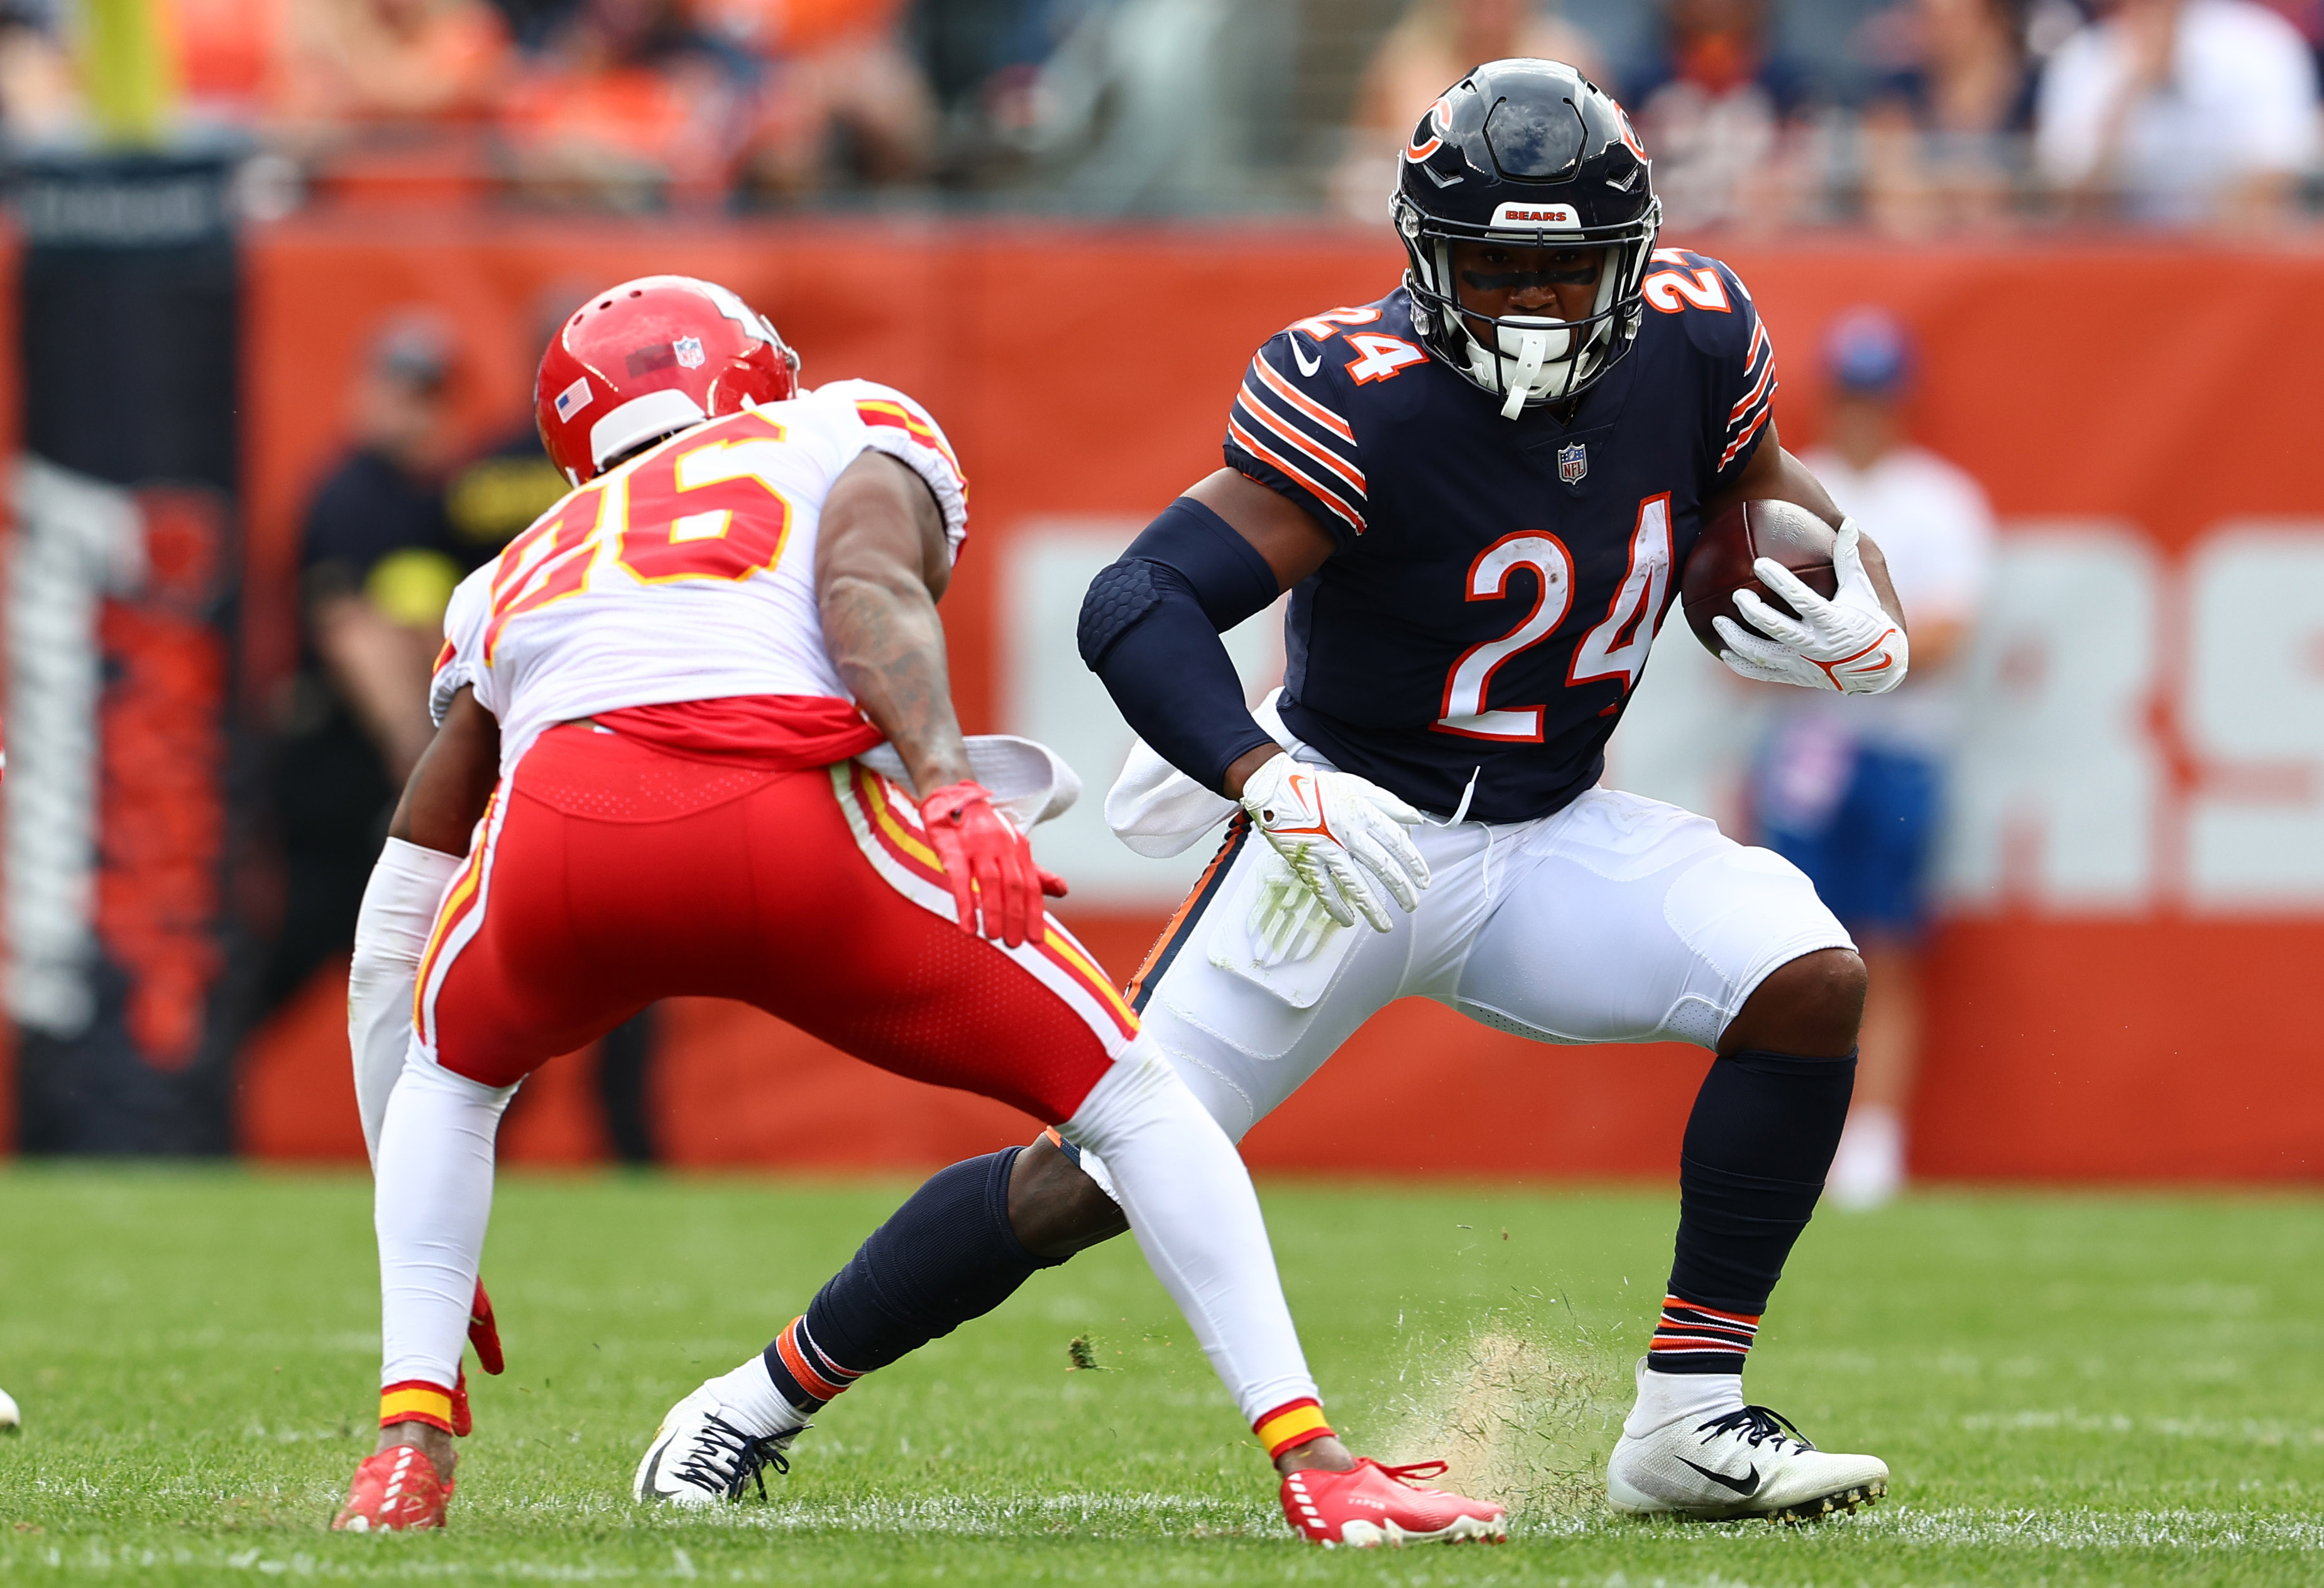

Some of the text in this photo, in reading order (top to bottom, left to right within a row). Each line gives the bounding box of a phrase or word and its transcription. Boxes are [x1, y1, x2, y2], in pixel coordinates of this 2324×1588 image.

[1505, 211, 1567, 222] BEARS
[1285, 306, 1431, 387] 24
[1564, 461, 1584, 478] NFL
[484, 410, 791, 667] 26
[1429, 490, 1675, 743] 24
